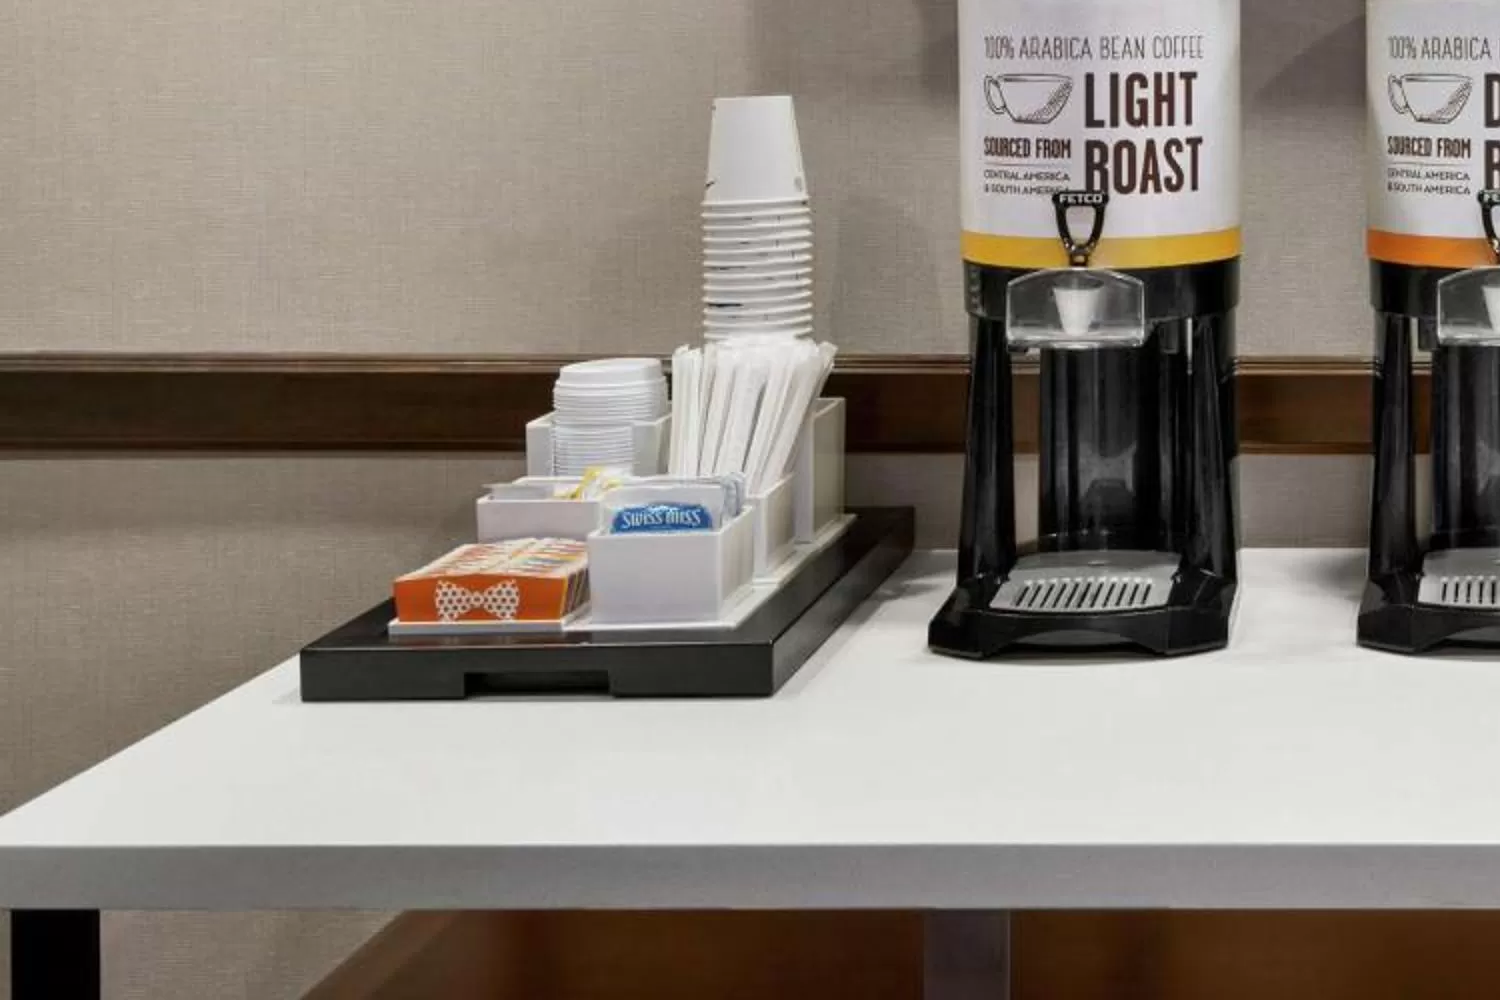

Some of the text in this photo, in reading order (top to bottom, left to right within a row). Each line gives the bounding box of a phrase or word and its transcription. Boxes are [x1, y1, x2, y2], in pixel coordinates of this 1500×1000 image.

[1019, 37, 1092, 60] ARABICA
[1100, 36, 1145, 60] BEAN
[1153, 35, 1204, 59] COFFEE
[1421, 37, 1492, 60] ARABICA
[1085, 72, 1198, 128] LIGHT
[983, 136, 1071, 159] SOURCED FROM
[1387, 136, 1471, 159] SOURCED FROM
[1023, 171, 1070, 181] AMERICA
[1085, 136, 1203, 195] ROAST
[1423, 170, 1471, 181] AMERICA
[1423, 184, 1471, 195] AMERICA
